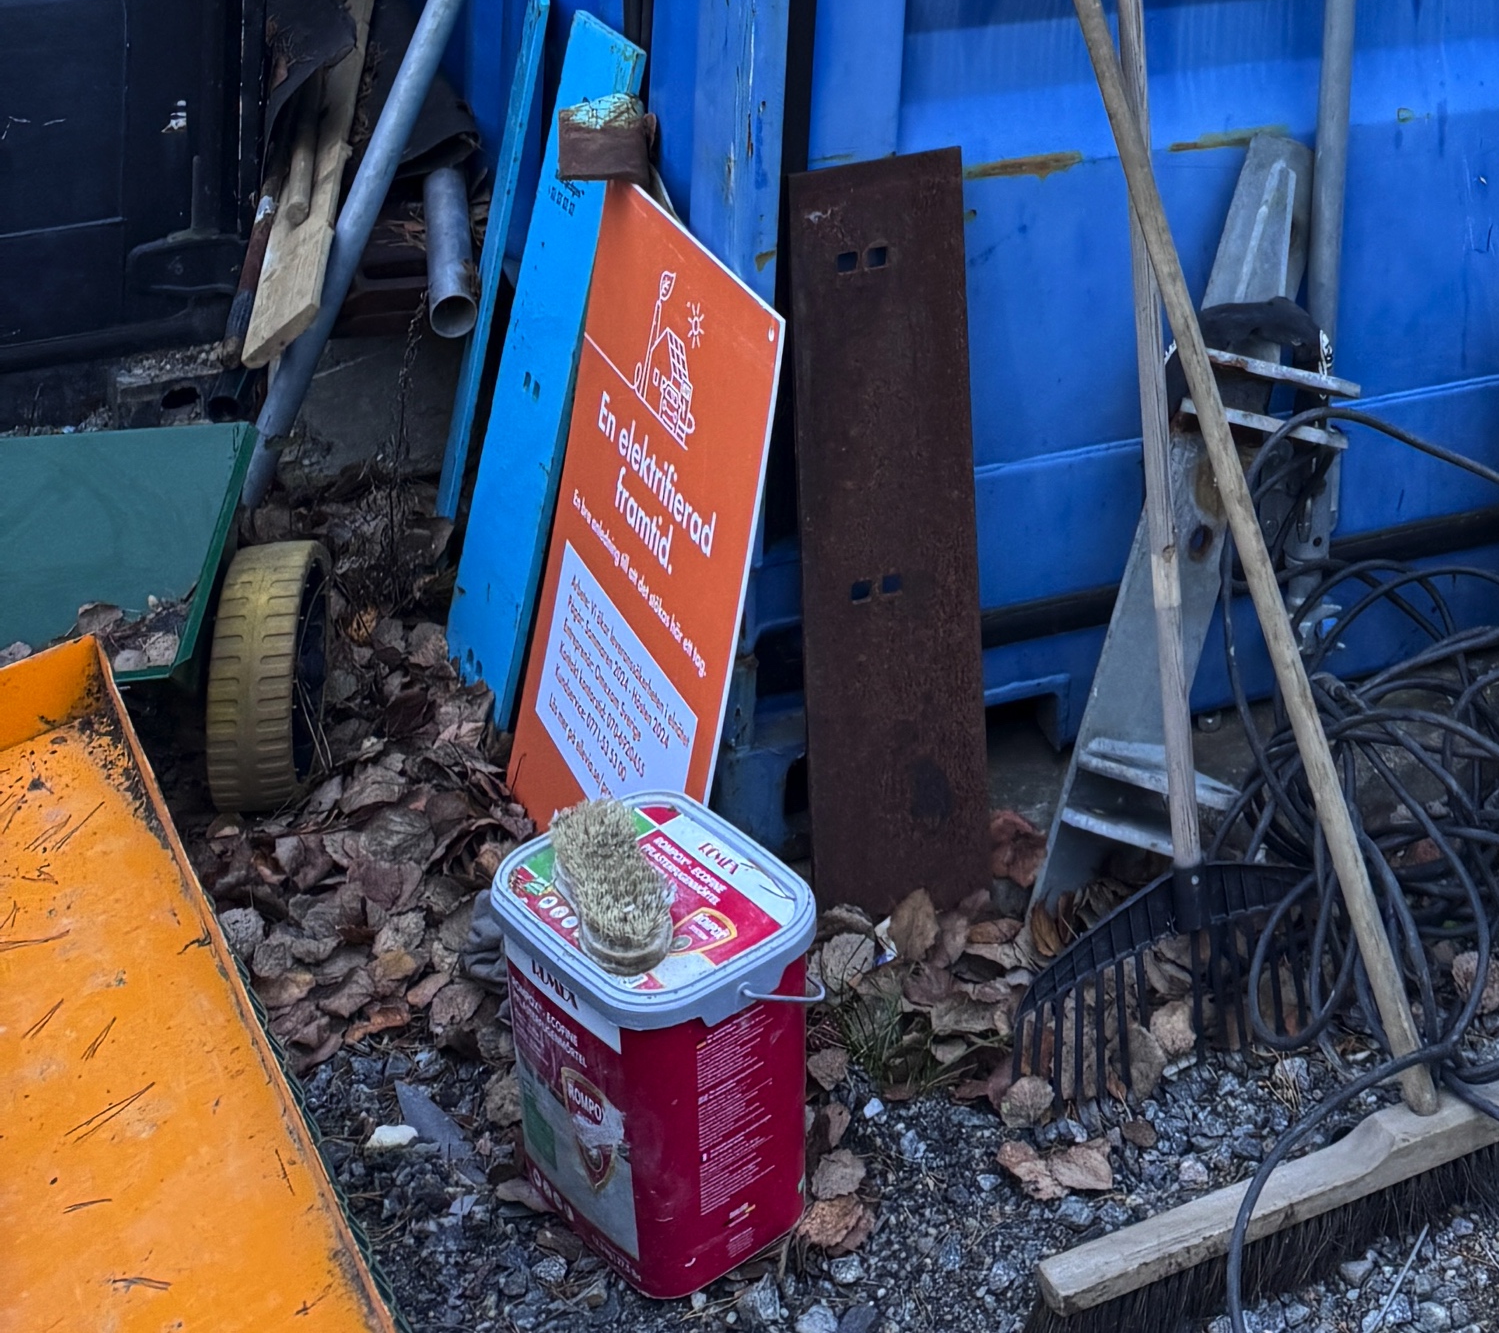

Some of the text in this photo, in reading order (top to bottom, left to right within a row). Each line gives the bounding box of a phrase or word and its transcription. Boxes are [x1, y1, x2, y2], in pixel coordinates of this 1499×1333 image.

[598, 390, 716, 558] En elektrifierad
[614, 466, 673, 575] framtid.
[591, 600, 597, 619] Vi
[613, 661, 629, 692] 2024
[652, 717, 669, 749] 2024
[608, 748, 618, 769] 53
[618, 760, 626, 782] 00
